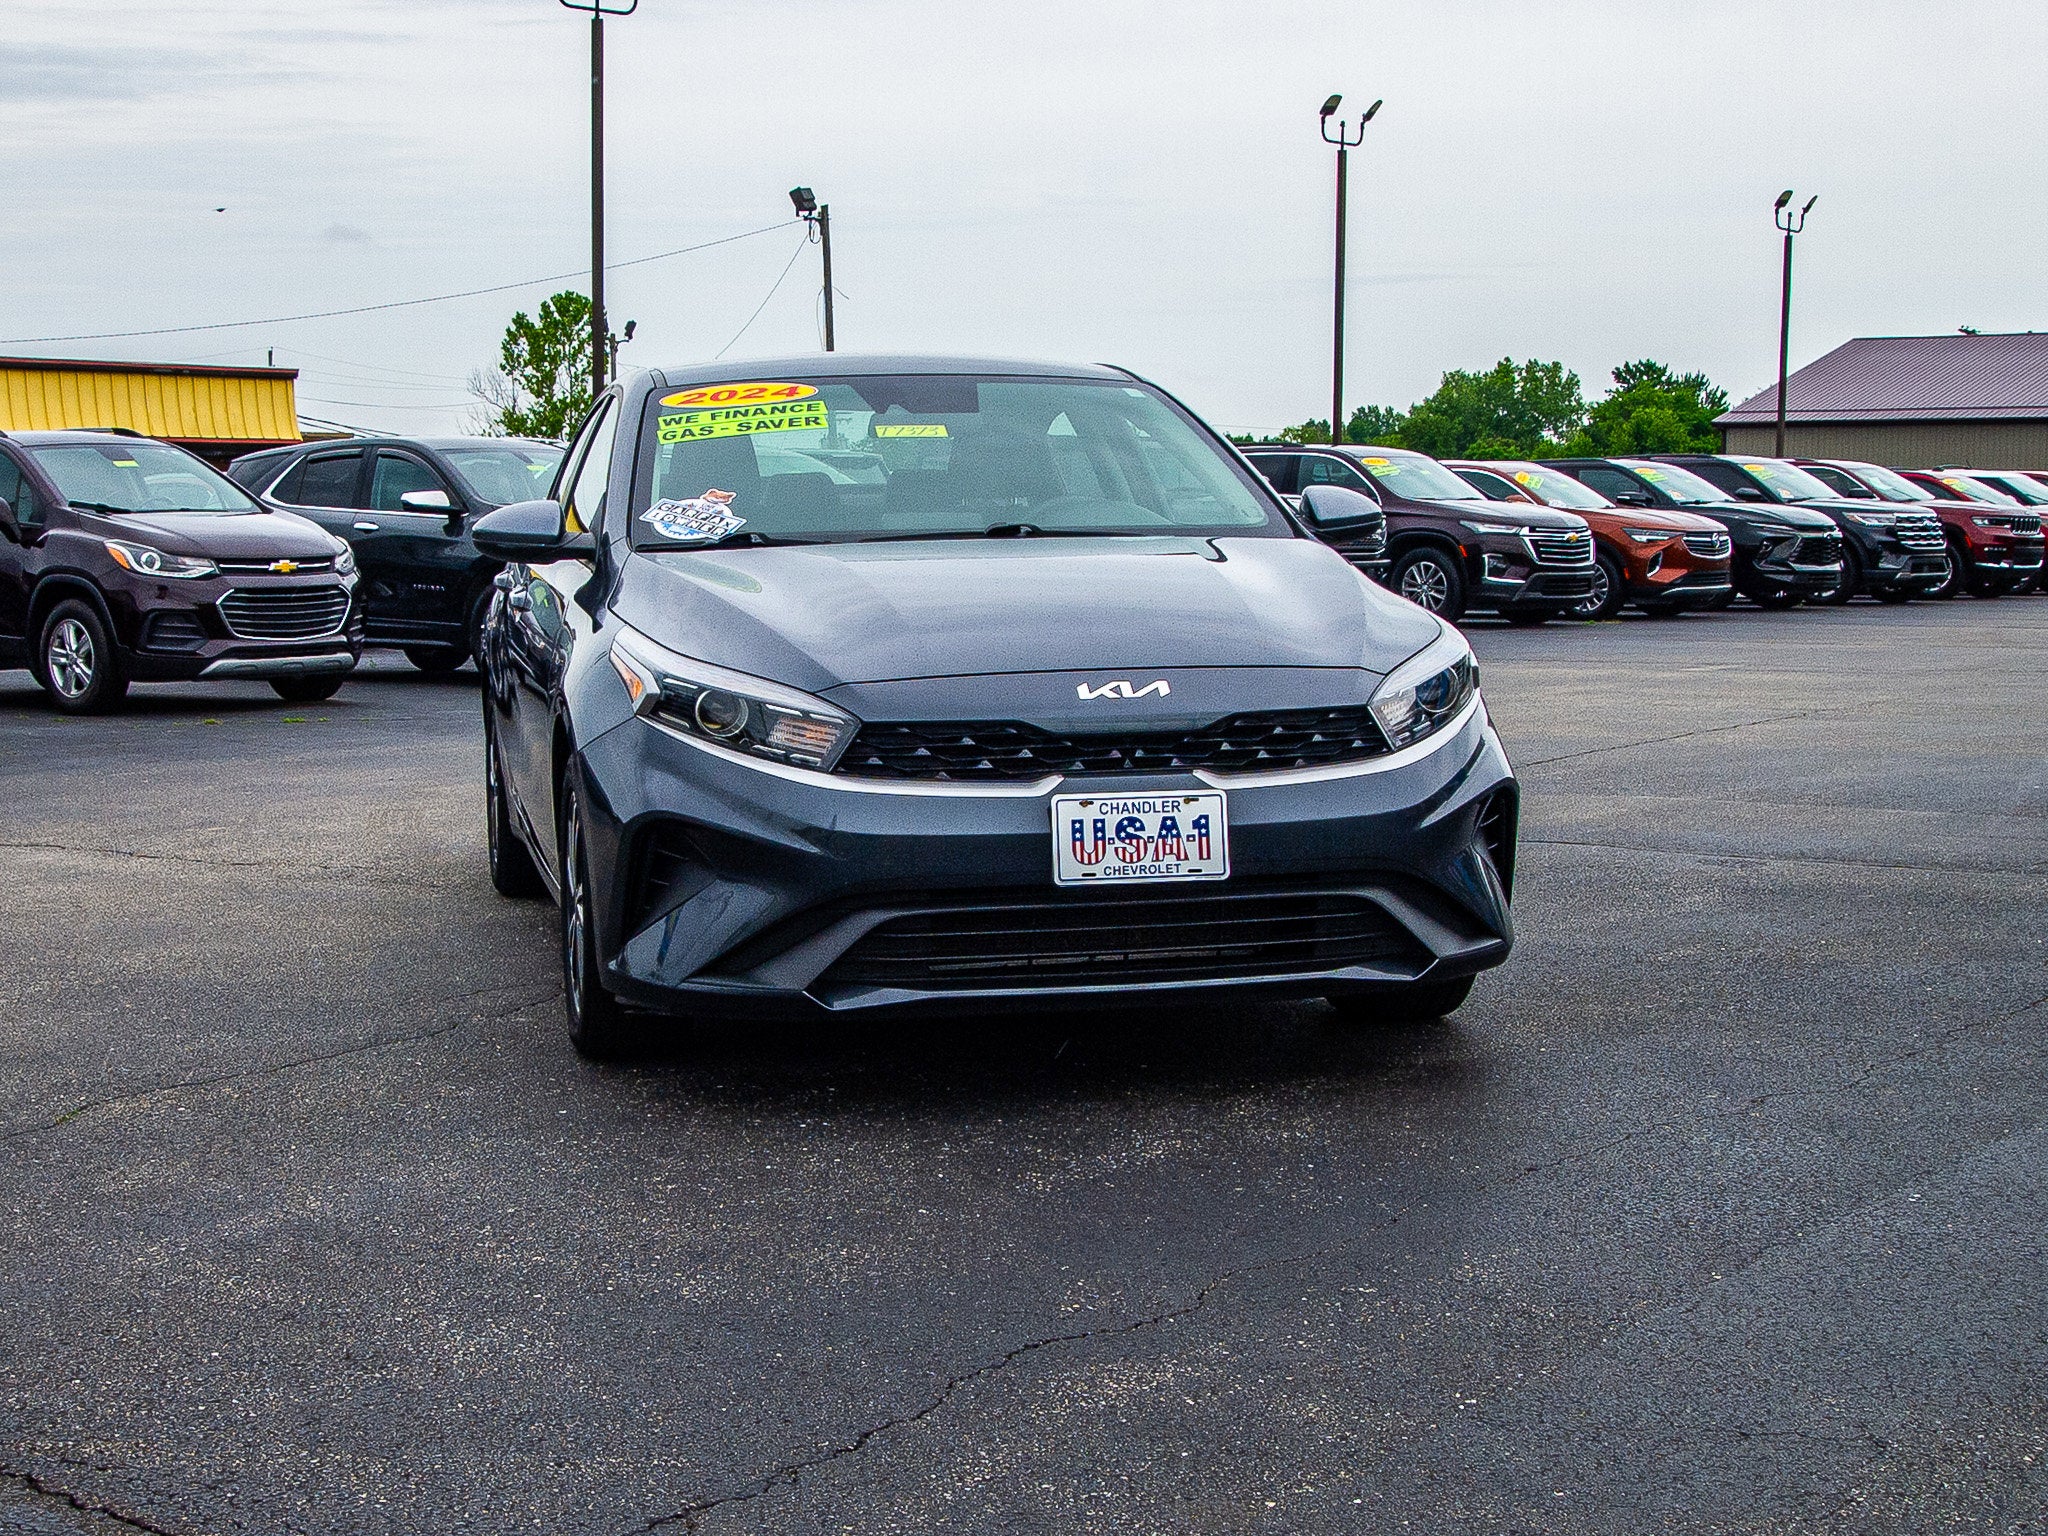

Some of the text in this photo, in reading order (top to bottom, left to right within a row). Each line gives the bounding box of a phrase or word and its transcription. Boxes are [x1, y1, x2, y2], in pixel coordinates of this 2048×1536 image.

[677, 385, 800, 406] 2024
[662, 402, 821, 426] WE FINANCE
[662, 425, 714, 441] GAS
[736, 416, 821, 432] SAVER
[1076, 680, 1171, 700] KIA
[1099, 800, 1181, 815] CHANDLER
[1103, 863, 1181, 876] CHEVROLET
